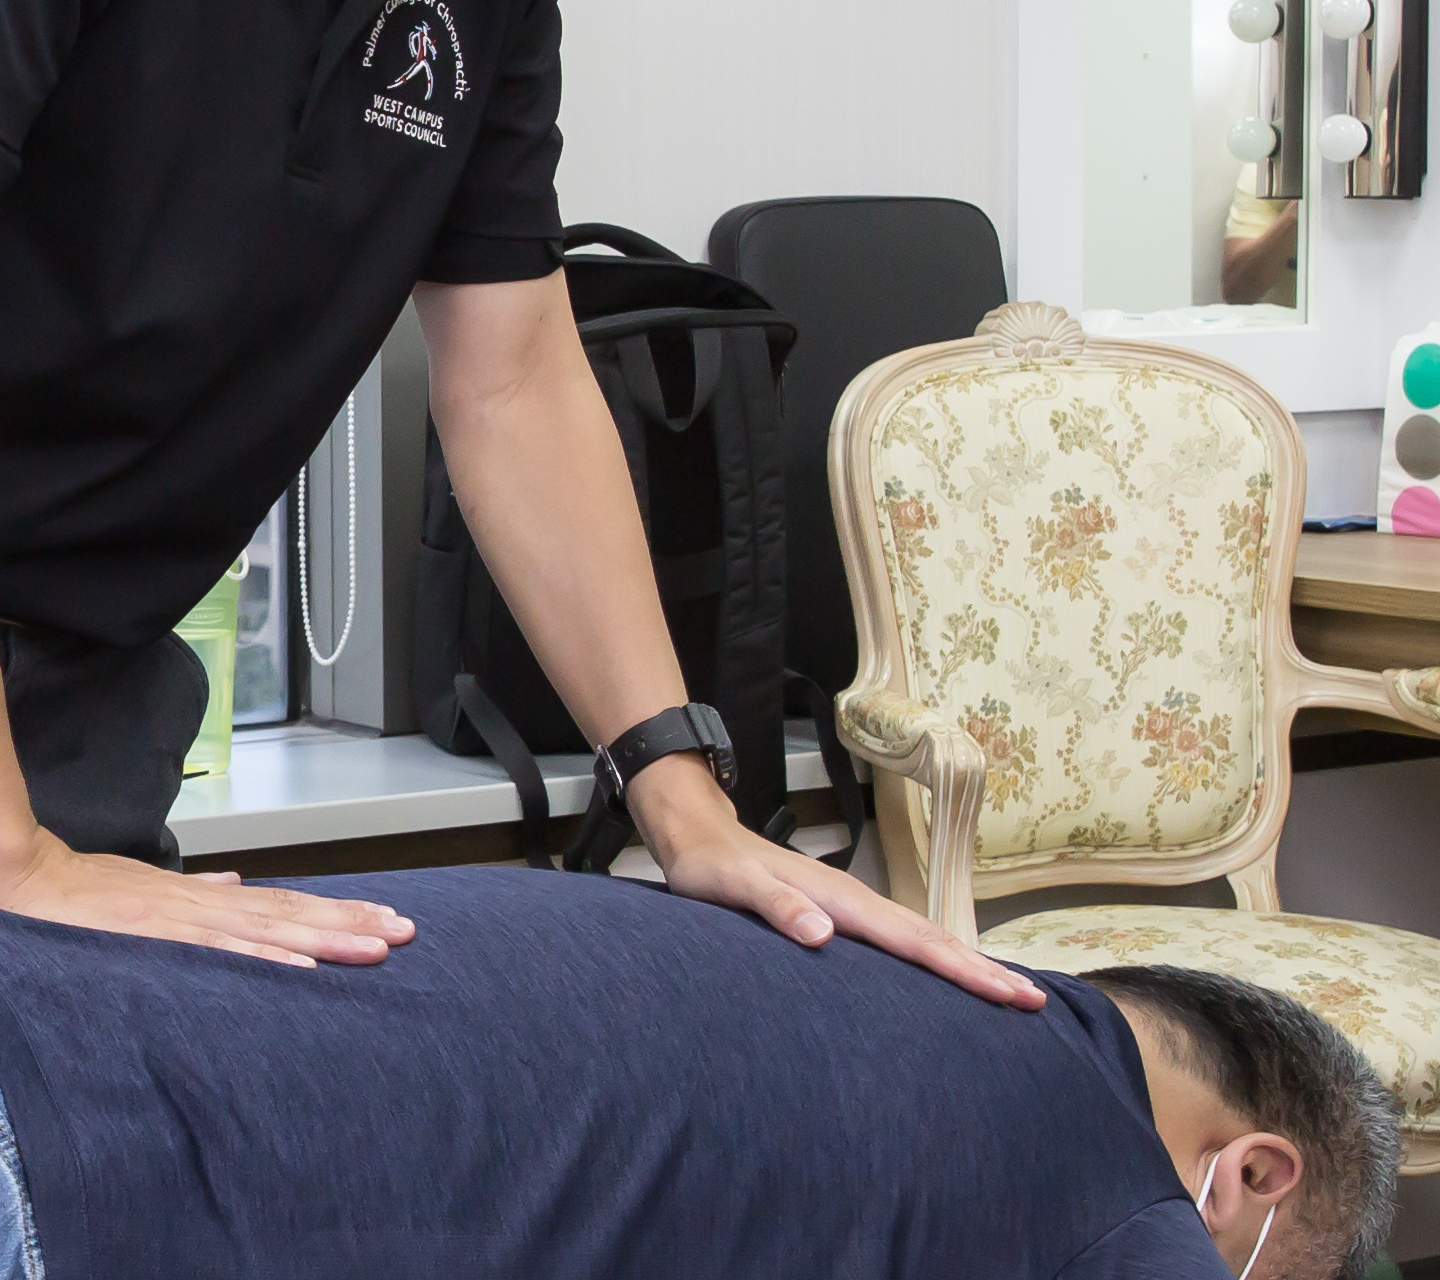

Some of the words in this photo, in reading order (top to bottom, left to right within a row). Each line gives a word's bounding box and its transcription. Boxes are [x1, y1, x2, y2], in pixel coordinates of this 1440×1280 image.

[362, 11, 386, 67] Palmer
[437, 2, 471, 101] Chiropractic
[364, 108, 404, 132] SPORTS
[404, 122, 447, 148] COUNCIL
[373, 94, 404, 115] WEST
[404, 105, 444, 129] CAMPUS
